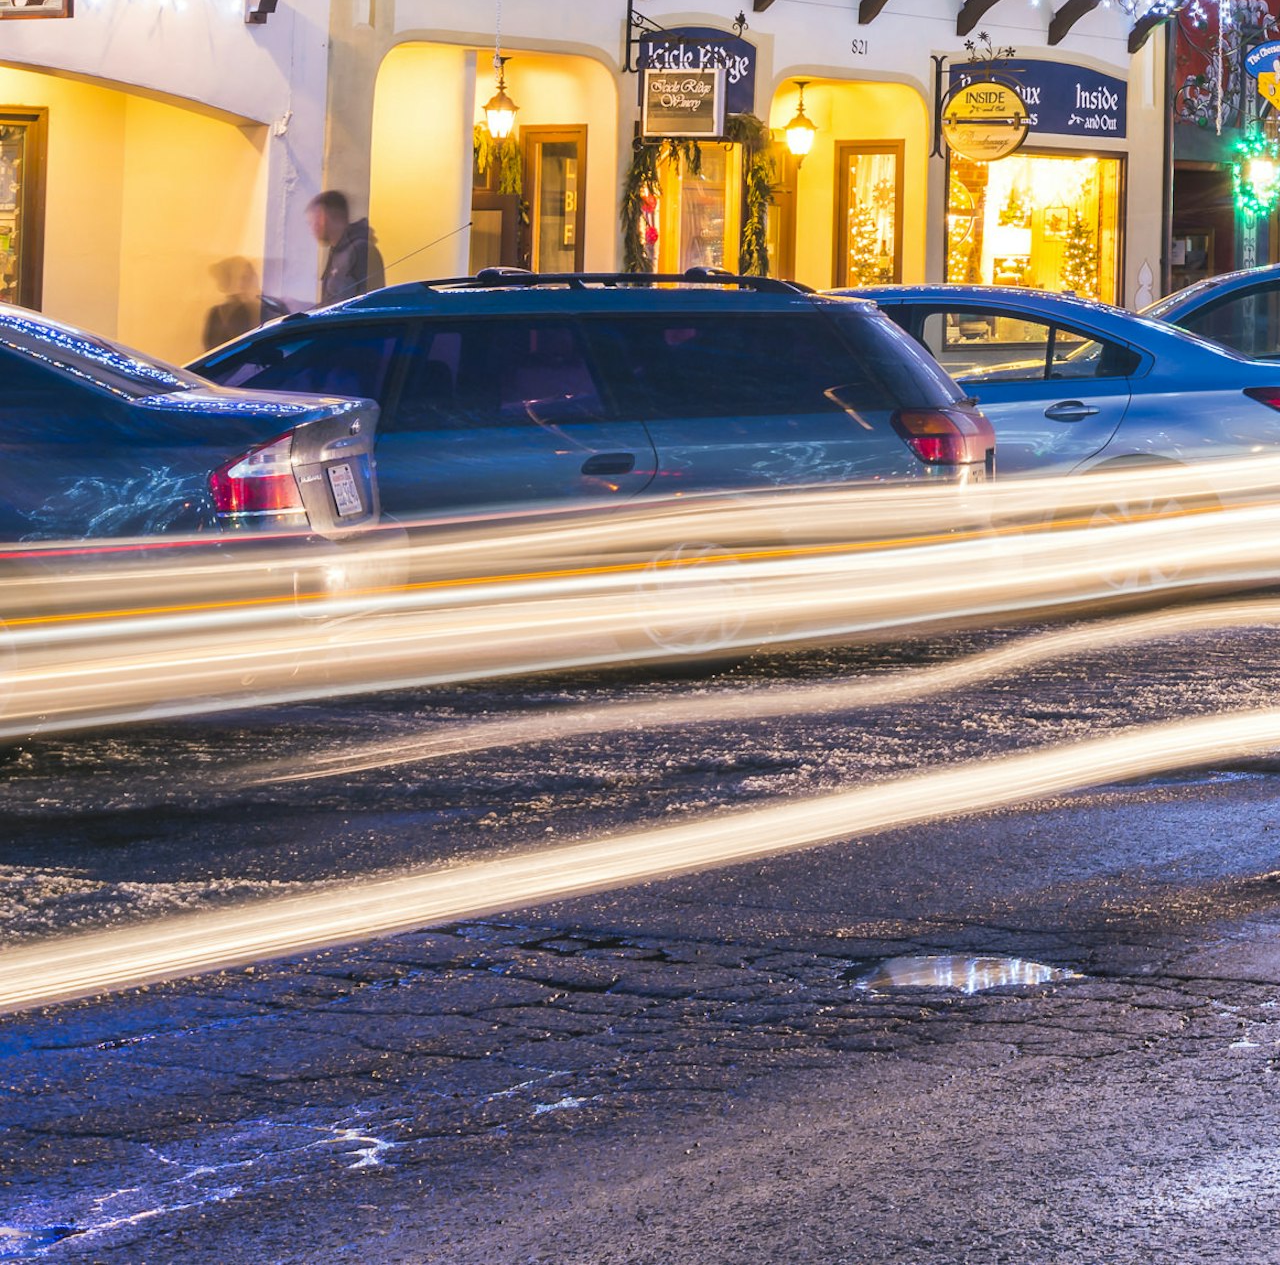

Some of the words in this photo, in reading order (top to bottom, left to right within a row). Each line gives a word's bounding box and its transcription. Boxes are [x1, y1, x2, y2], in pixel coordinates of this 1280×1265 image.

[851, 38, 868, 55] 821
[1247, 54, 1261, 66] The
[651, 79, 681, 93] Icicle
[680, 78, 712, 97] Ridge
[660, 93, 701, 112] Winery
[965, 91, 1006, 104] INSIDE
[1075, 83, 1119, 111] Inside
[1084, 114, 1100, 130] and
[1100, 114, 1118, 131] Out
